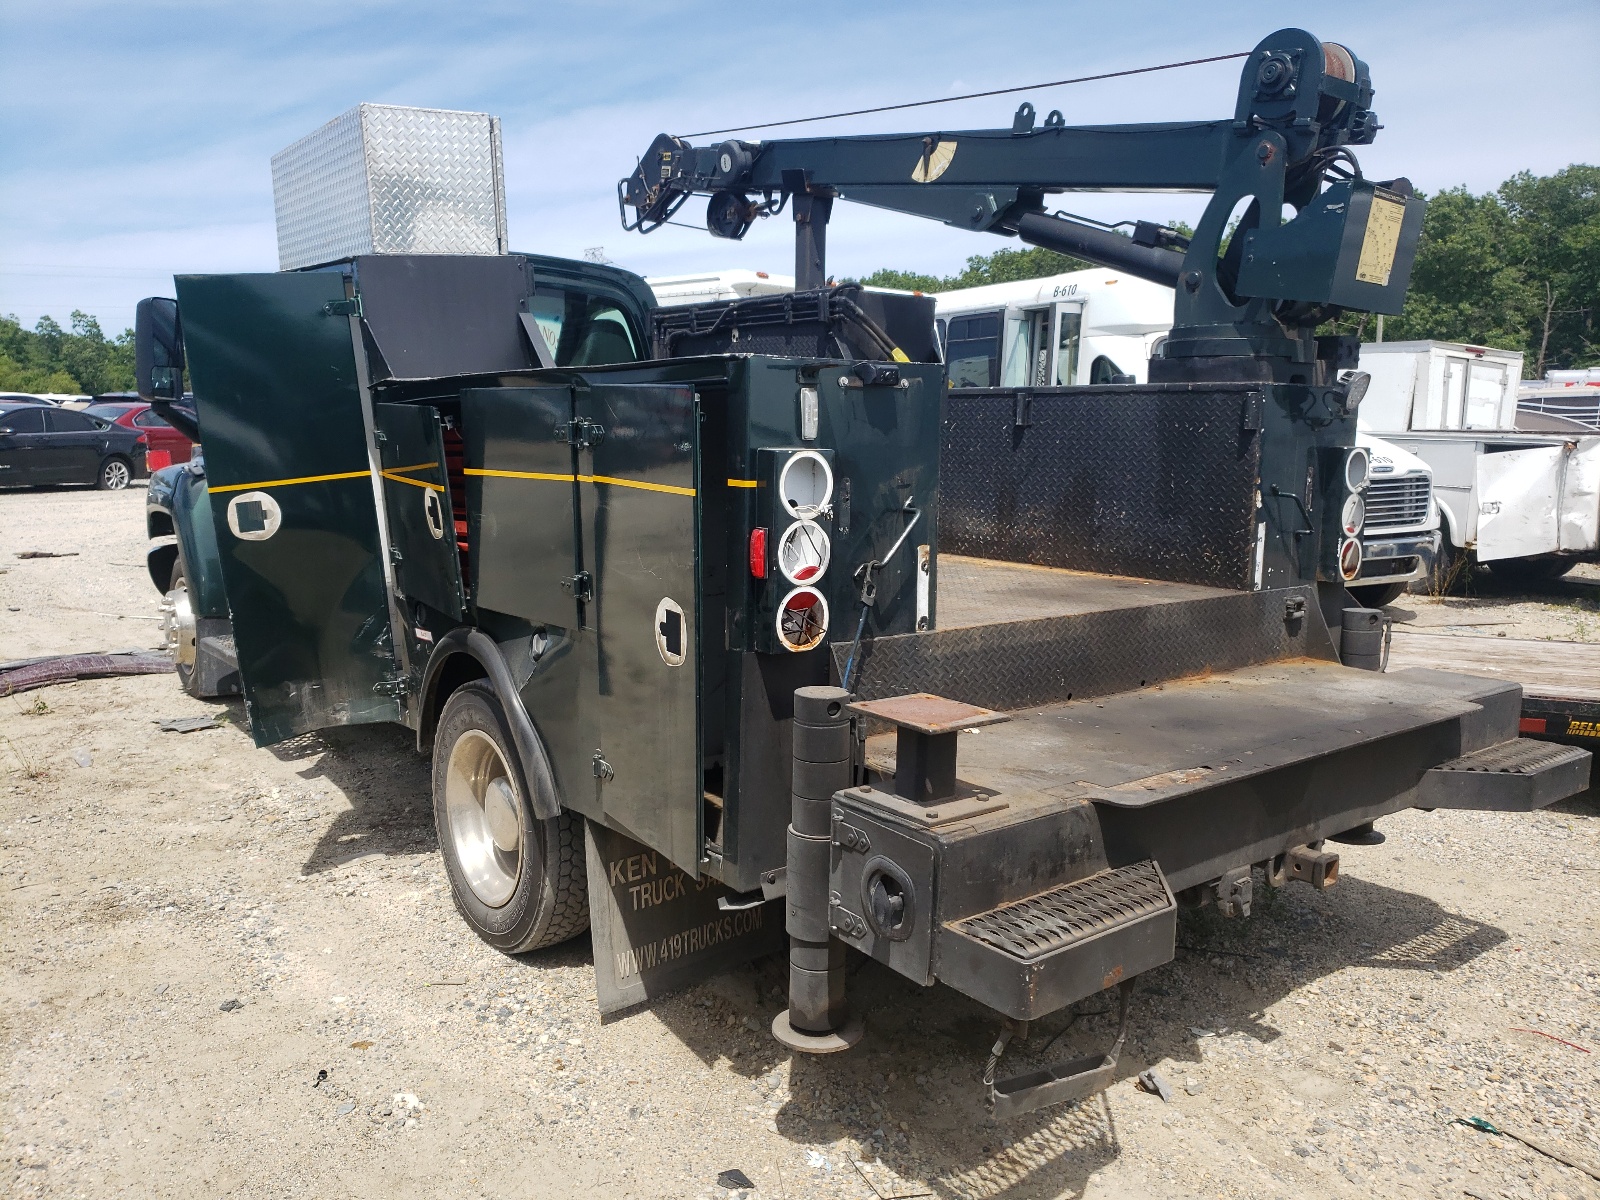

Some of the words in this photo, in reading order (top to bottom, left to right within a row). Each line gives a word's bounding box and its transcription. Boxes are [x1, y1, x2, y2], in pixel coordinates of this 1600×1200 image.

[1053, 284, 1078, 298] B-610
[609, 850, 657, 887] KEN
[628, 872, 687, 911] TRUCK
[616, 906, 763, 980] WWW.419TRUCKS.COM
